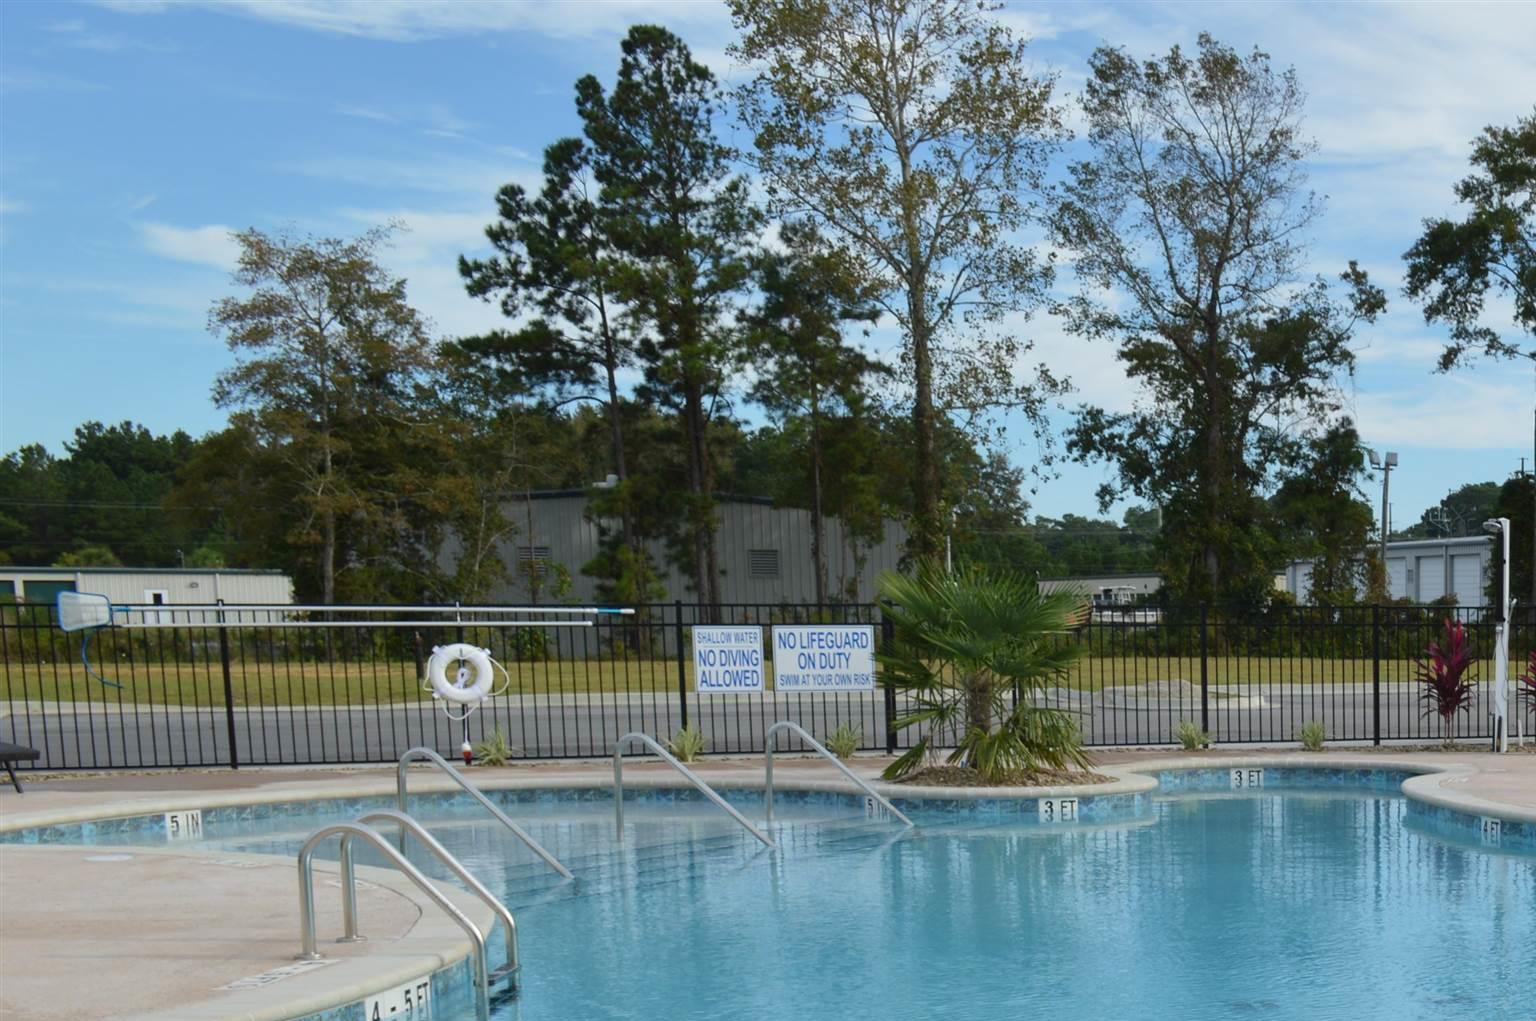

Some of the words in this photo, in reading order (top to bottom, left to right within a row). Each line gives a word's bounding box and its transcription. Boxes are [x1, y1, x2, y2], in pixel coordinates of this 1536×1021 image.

[697, 632, 731, 644] SHALLOW
[734, 632, 758, 644] WATER
[778, 632, 796, 649] NO
[800, 632, 869, 649] LIFEGUARD
[698, 649, 716, 667] NO
[719, 649, 759, 667] DIVING
[798, 652, 816, 669] ON
[819, 652, 851, 669] DUTY
[700, 670, 759, 687] ALLOWED
[780, 674, 799, 686] SWIM
[801, 673, 810, 685] AT
[812, 673, 833, 685] YOUR
[835, 673, 852, 685] OWN
[854, 673, 870, 685] RISK
[1045, 801, 1053, 814] 3
[170, 815, 179, 830] 5
[404, 989, 413, 1013] 5
